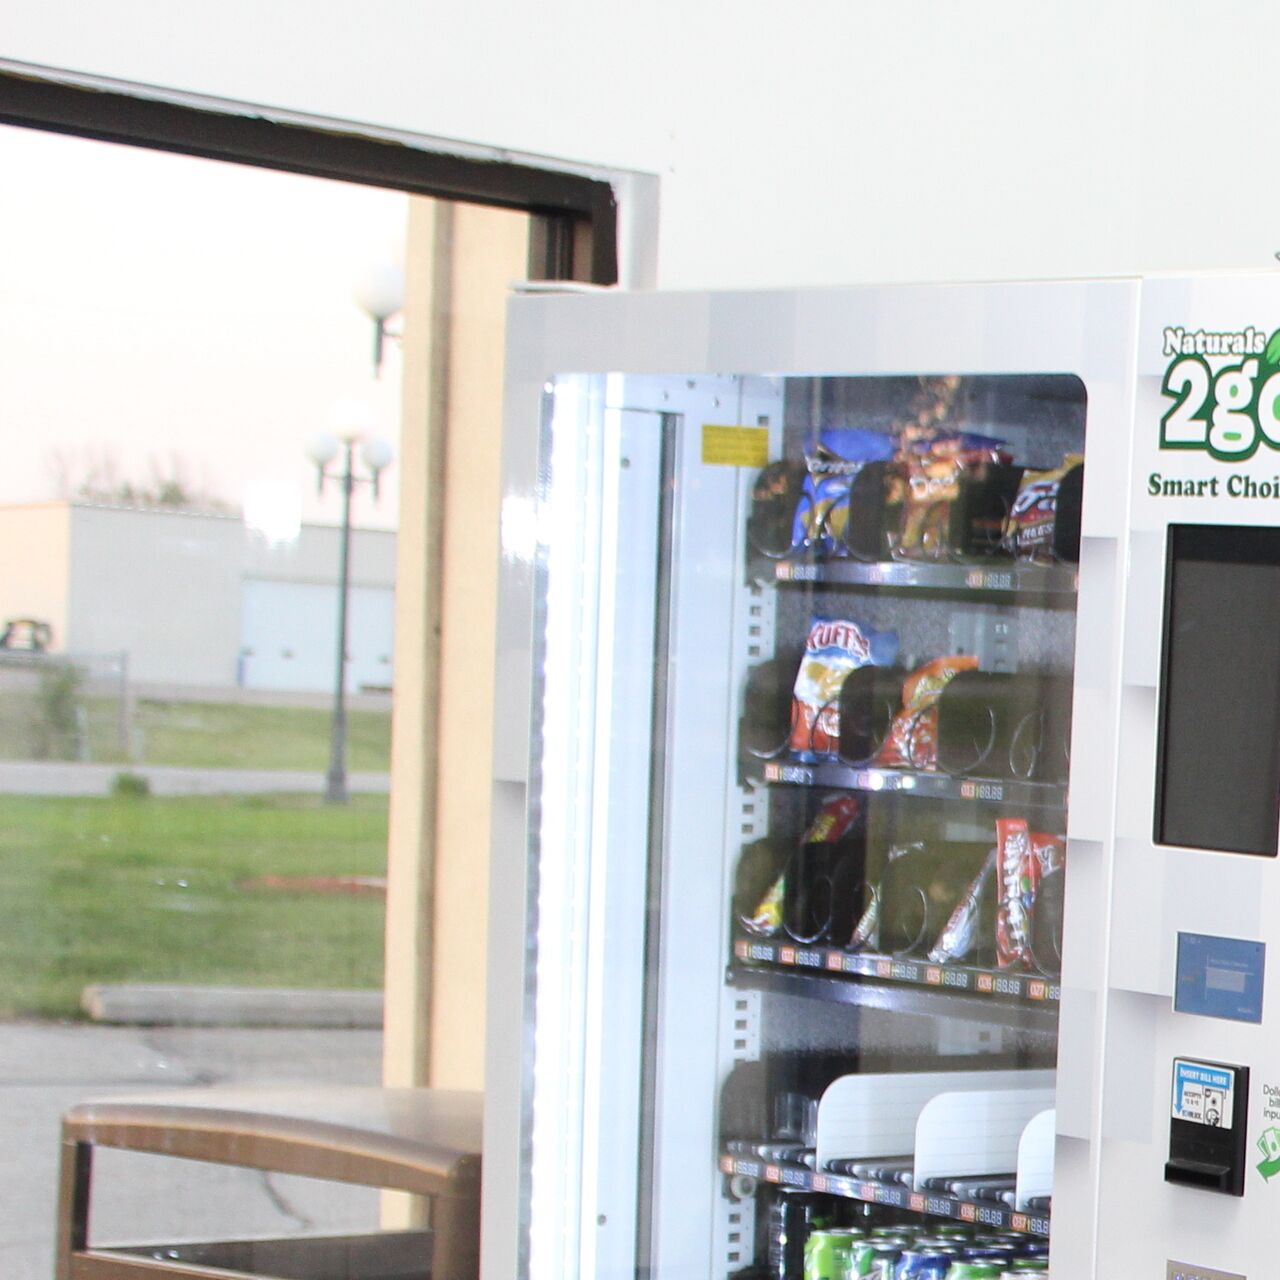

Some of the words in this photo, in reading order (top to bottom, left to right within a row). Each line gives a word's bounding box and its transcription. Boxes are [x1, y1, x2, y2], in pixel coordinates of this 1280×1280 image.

[1163, 327, 1266, 356] Naturals
[1148, 473, 1219, 497] Smart
[1269, 1096, 1280, 1108] bill
